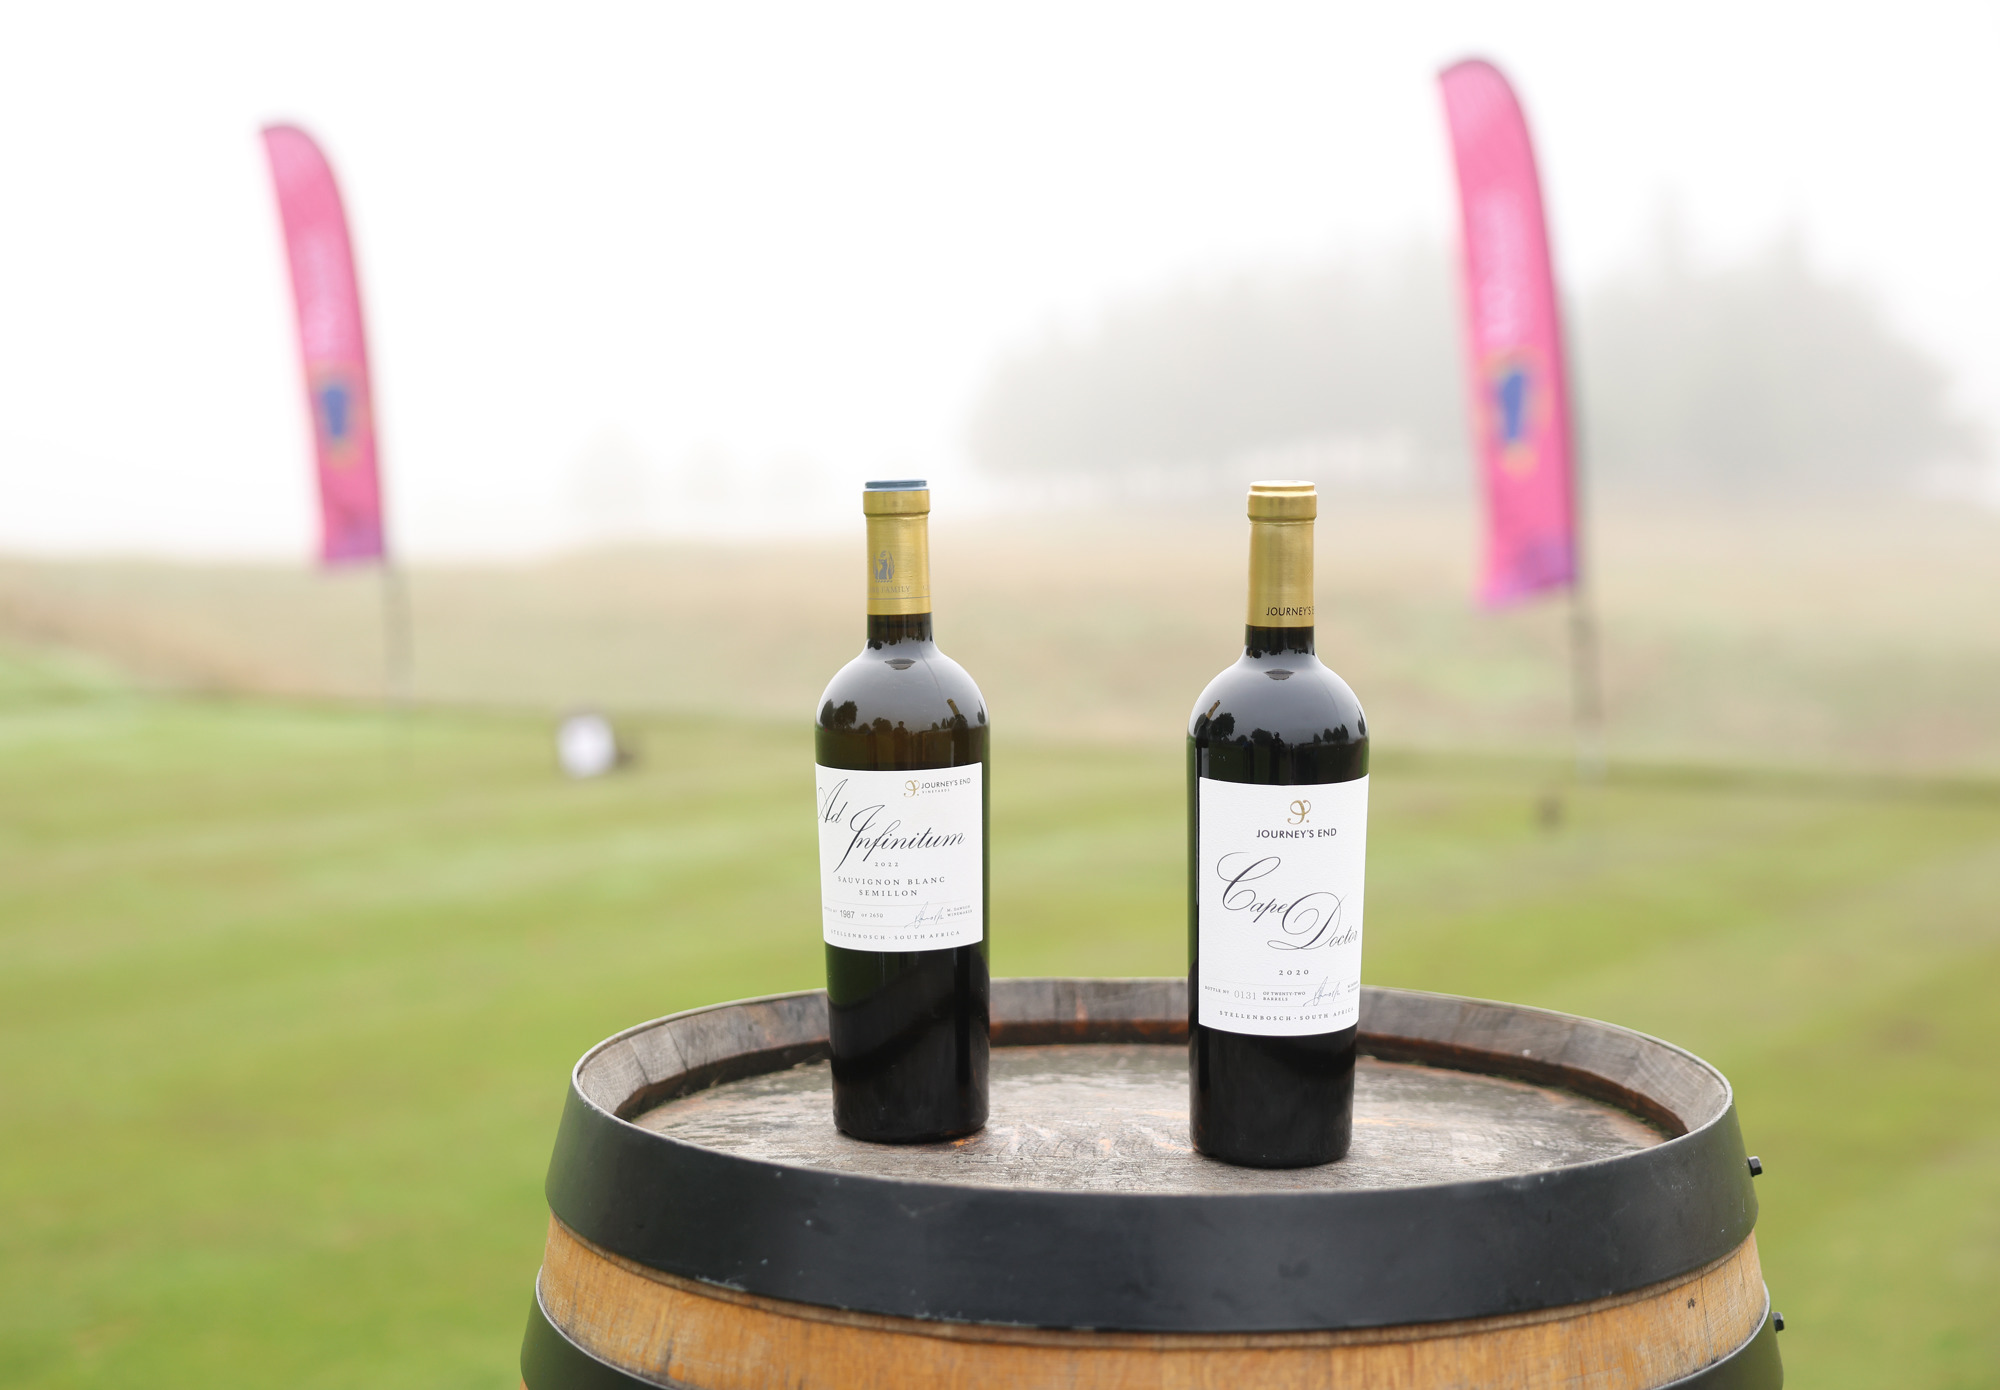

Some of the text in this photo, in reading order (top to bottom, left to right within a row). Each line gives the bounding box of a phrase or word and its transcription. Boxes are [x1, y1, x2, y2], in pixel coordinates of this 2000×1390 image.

[1266, 606, 1311, 616] JOURNEY'S
[921, 779, 958, 789] JOURNEY'S
[959, 777, 971, 786] END
[818, 779, 848, 823] Ad
[832, 804, 965, 873] Infinitum
[1256, 828, 1337, 839] JOURNEY'S END
[837, 876, 945, 886] SAUVIGNON BLANC
[858, 889, 918, 897] SEMILLON
[1216, 851, 1358, 950] Cape Doctor
[840, 909, 855, 919] 1987
[830, 928, 886, 940] STELLENBOSCH
[929, 930, 960, 938] AFRICA
[1233, 989, 1257, 1001] 0131
[1219, 1007, 1354, 1021] STELLENBOSCH SOUTH AFRICA
